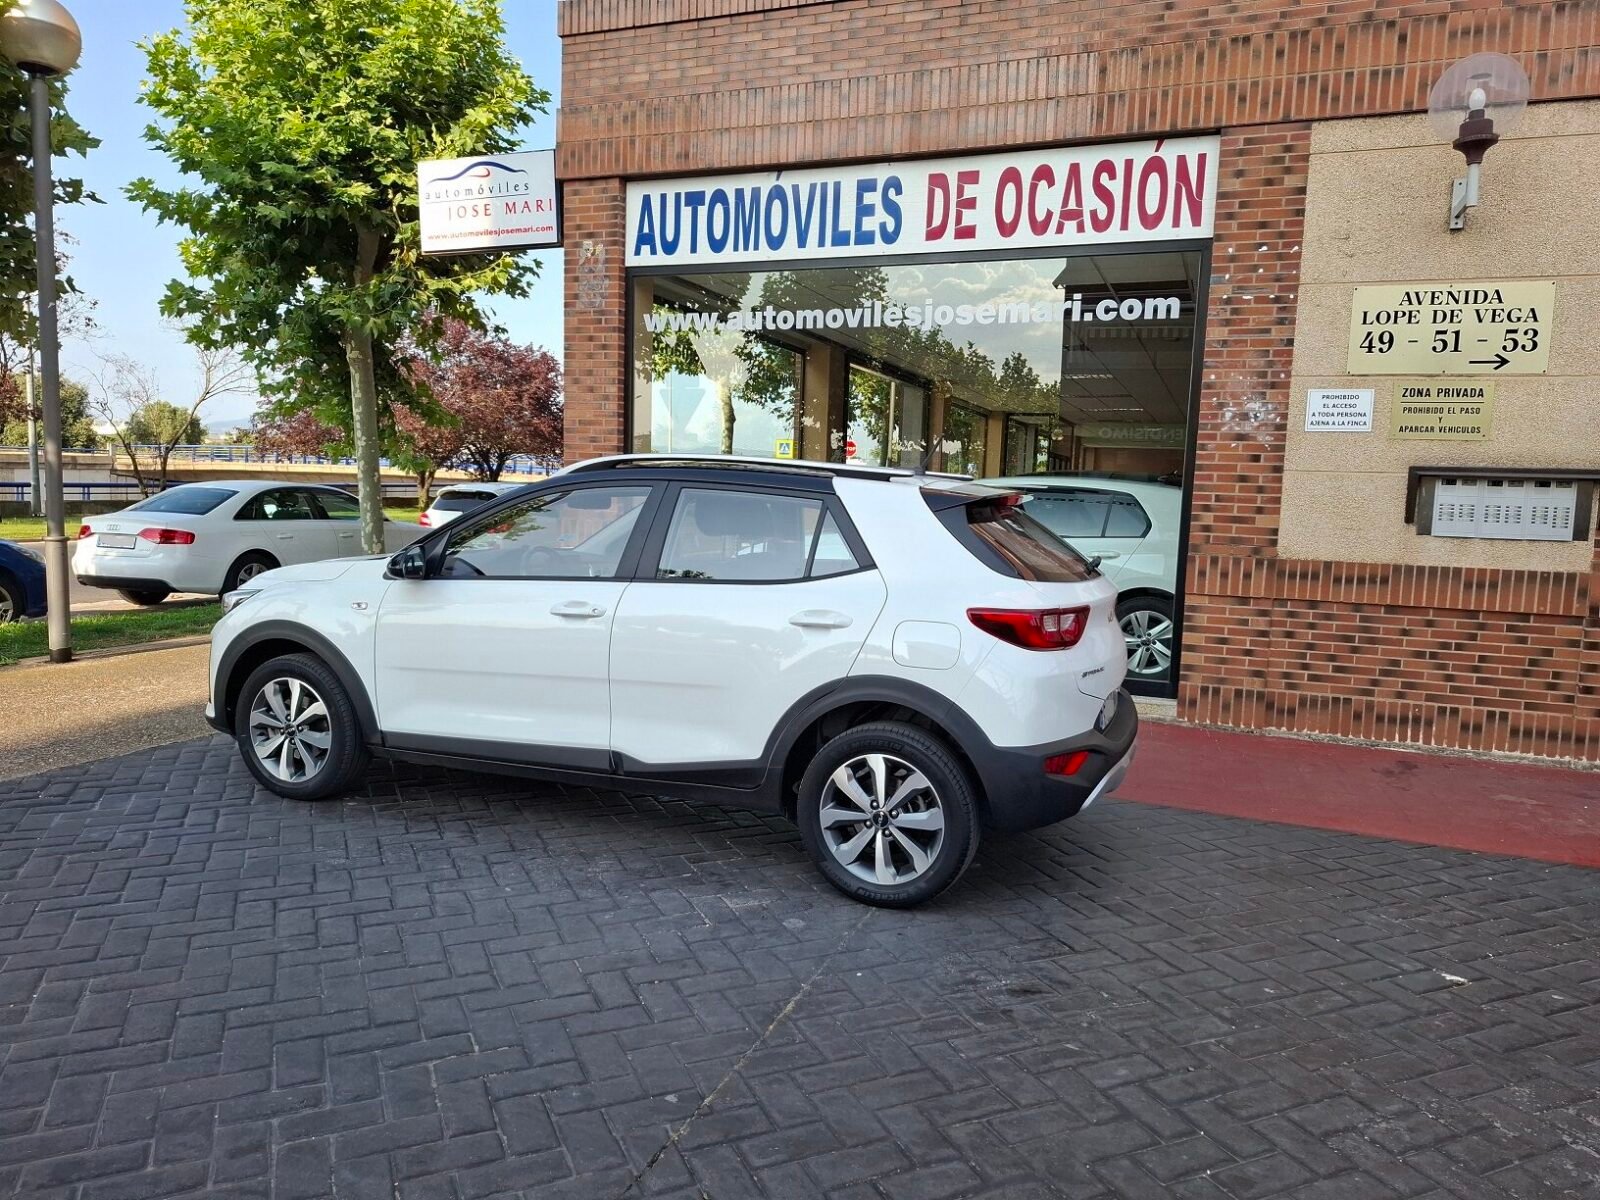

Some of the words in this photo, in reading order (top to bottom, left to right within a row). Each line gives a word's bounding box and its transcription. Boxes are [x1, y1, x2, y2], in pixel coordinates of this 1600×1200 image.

[425, 182, 529, 200] automóviles
[634, 171, 903, 257] AUTOMÓVILES
[925, 170, 980, 242] DE
[994, 138, 1207, 239] OCASIÓN
[448, 203, 491, 221] JOSE
[505, 198, 553, 215] MARI
[1399, 289, 1504, 306] AVENIDA
[643, 293, 1181, 332] www.automovilesjosemari.com
[1361, 310, 1421, 325] LOPE
[1431, 309, 1463, 324] DE
[1474, 307, 1540, 324] VEGA
[1359, 330, 1395, 354] 49
[1431, 328, 1463, 353] 51
[1501, 327, 1539, 353] 53
[1402, 388, 1431, 398] ZONA
[1436, 388, 1484, 398] PRIVADA
[1438, 416, 1443, 424] Y
[1459, 407, 1481, 415] PASO
[1398, 425, 1435, 433] APARCAR
[1438, 425, 1481, 434] VEHICULOS
